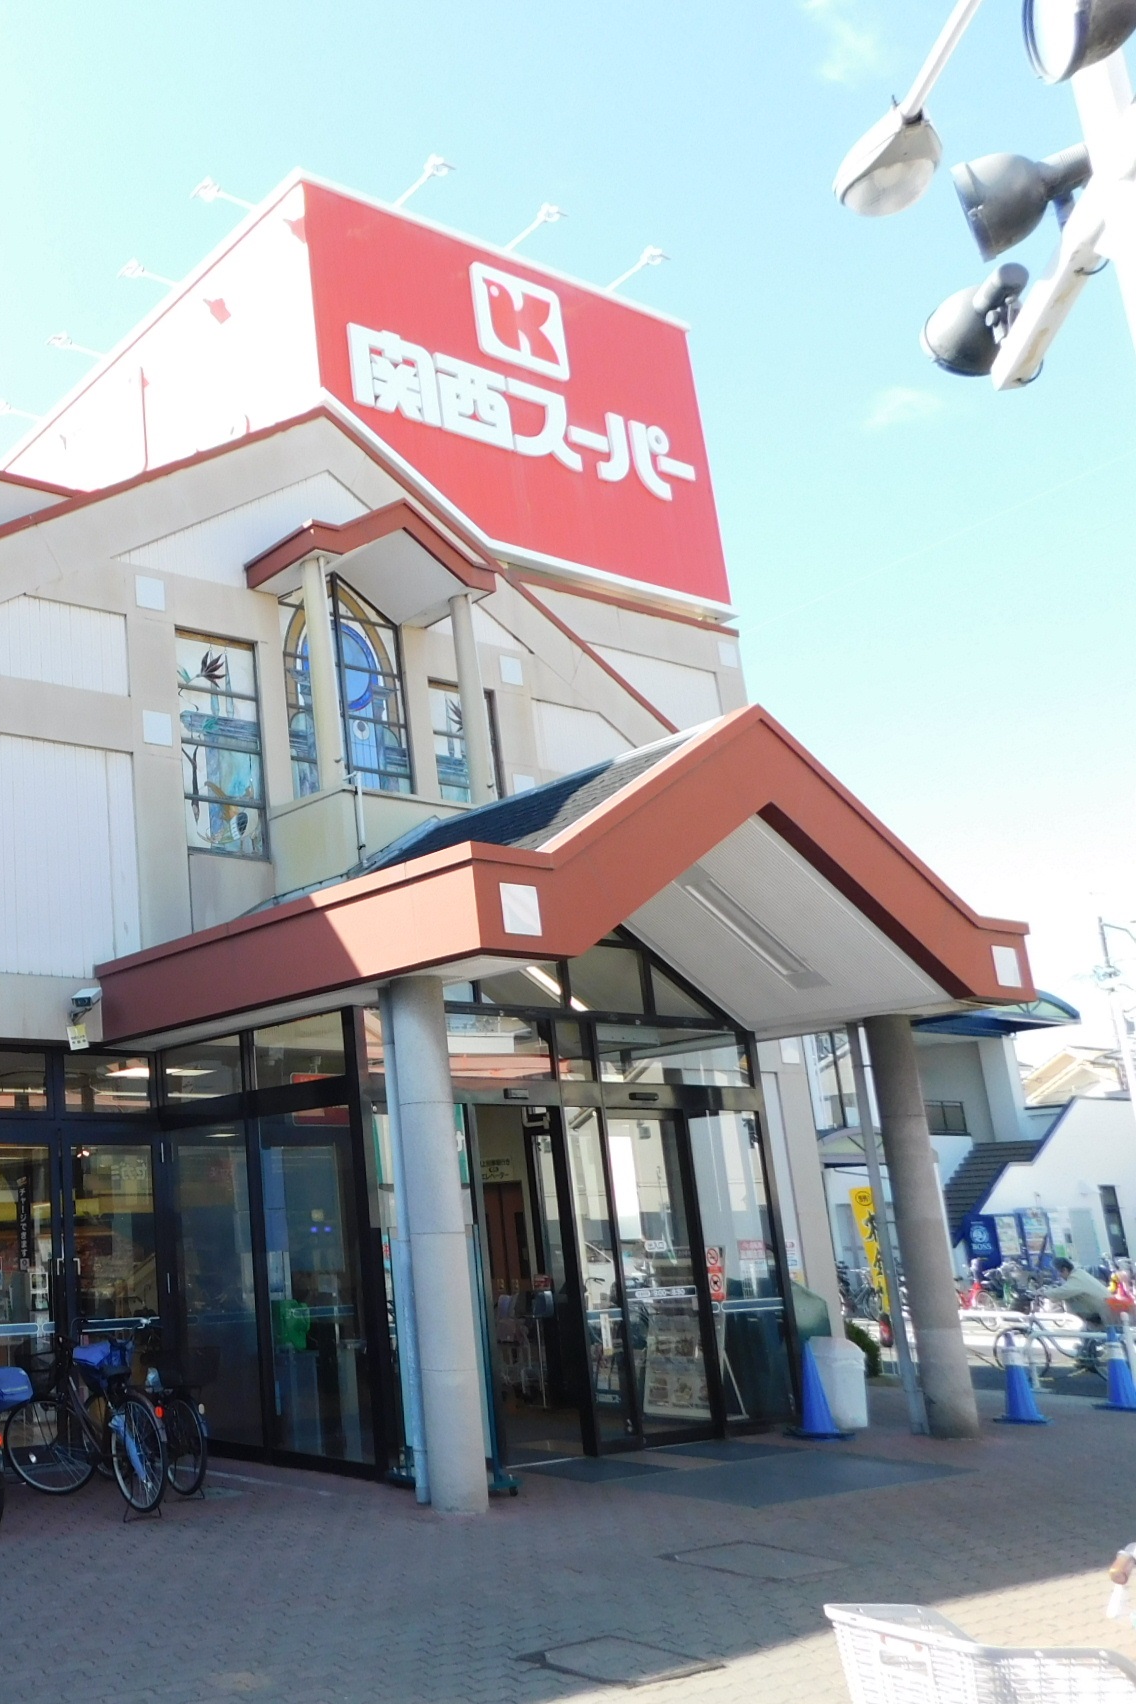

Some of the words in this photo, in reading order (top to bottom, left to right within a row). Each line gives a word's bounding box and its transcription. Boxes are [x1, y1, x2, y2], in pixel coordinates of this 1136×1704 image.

[346, 321, 697, 502] 関西スーパー
